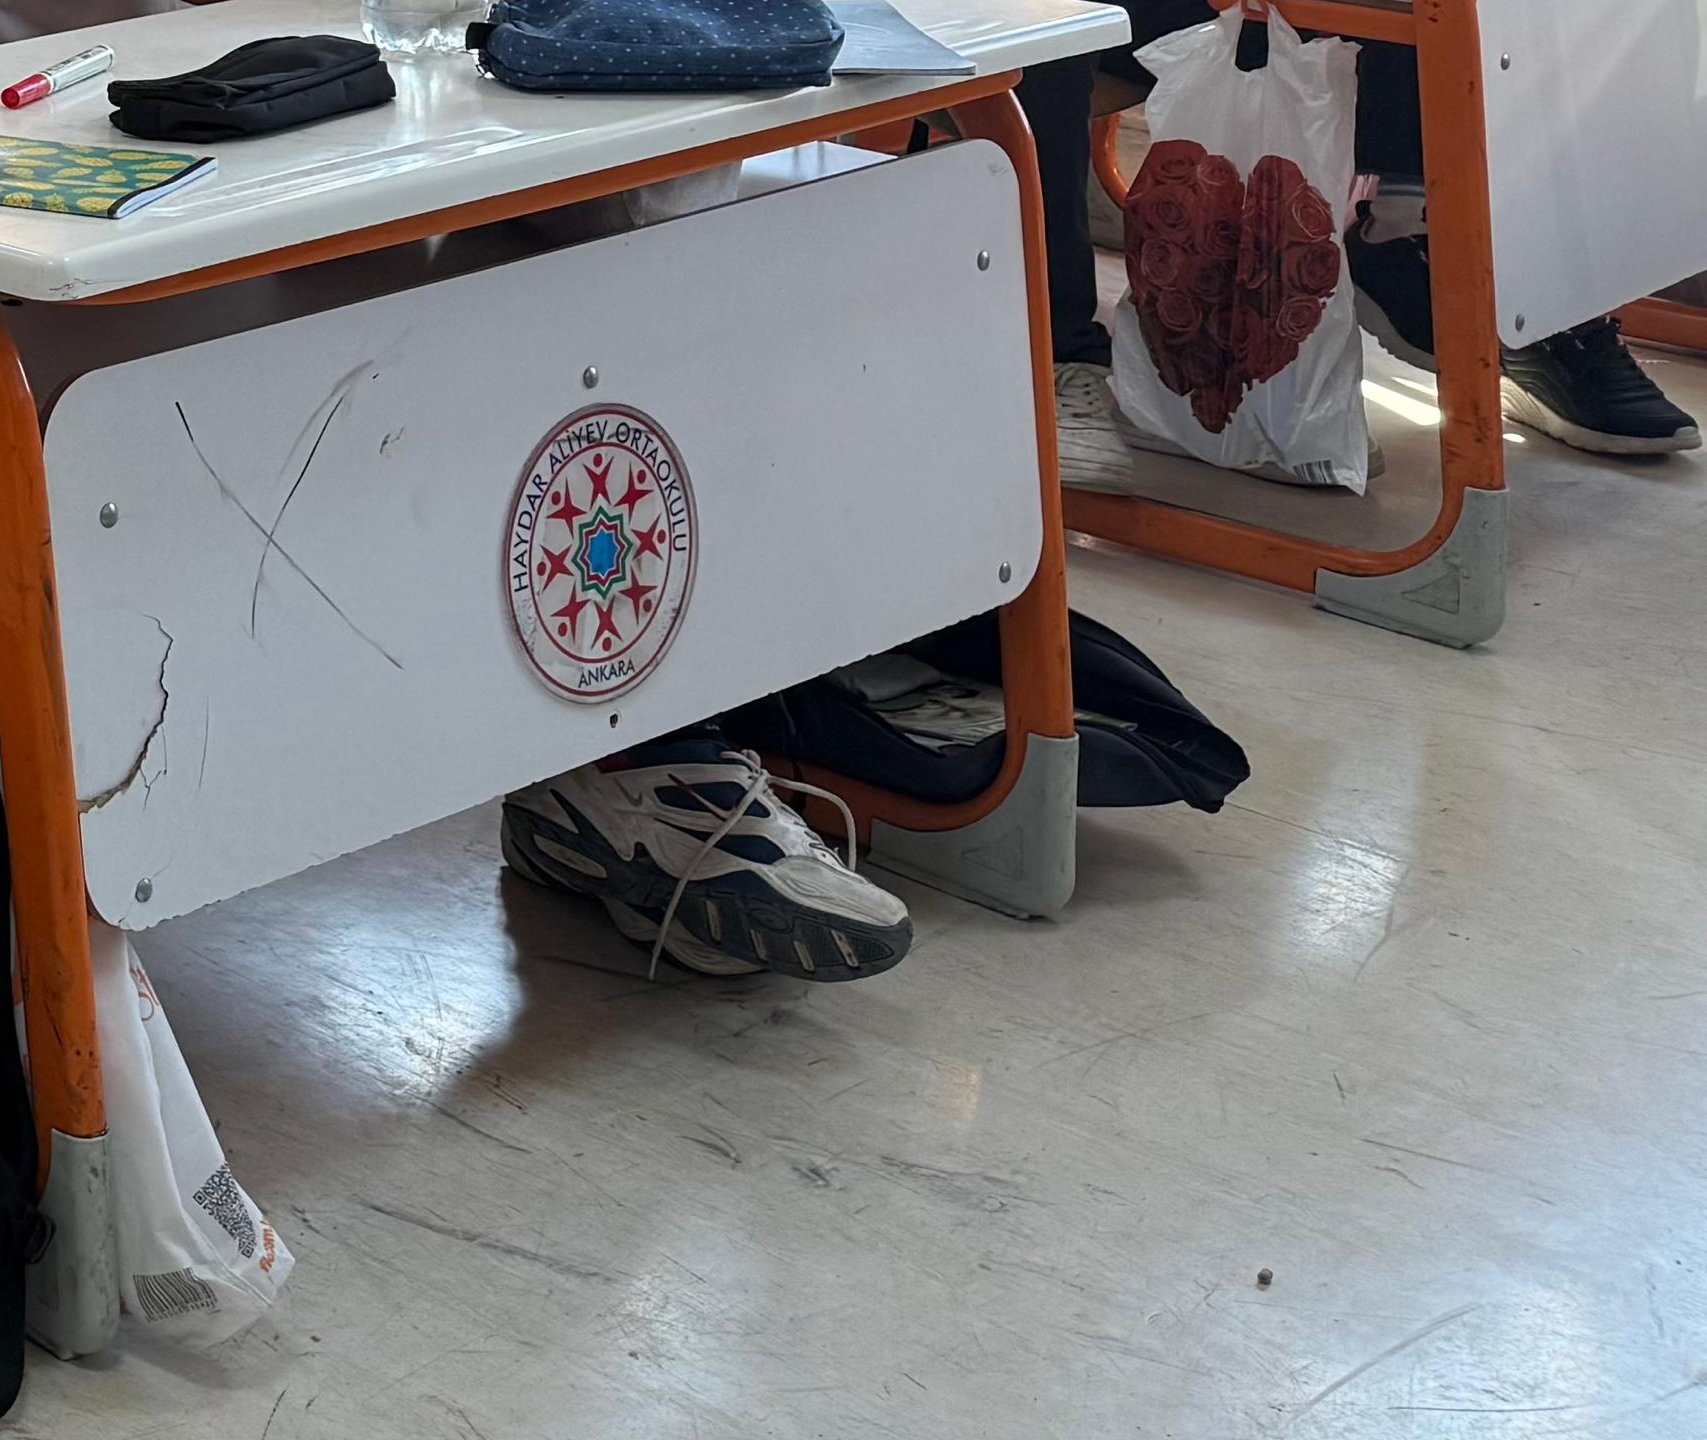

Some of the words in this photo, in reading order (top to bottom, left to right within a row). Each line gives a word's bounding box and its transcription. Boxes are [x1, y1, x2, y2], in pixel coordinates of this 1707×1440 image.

[513, 473, 550, 593] HAYDAR
[548, 420, 609, 476] ALİYEV
[615, 421, 688, 554] ORTAOKULU
[577, 657, 637, 690] ANKARA
